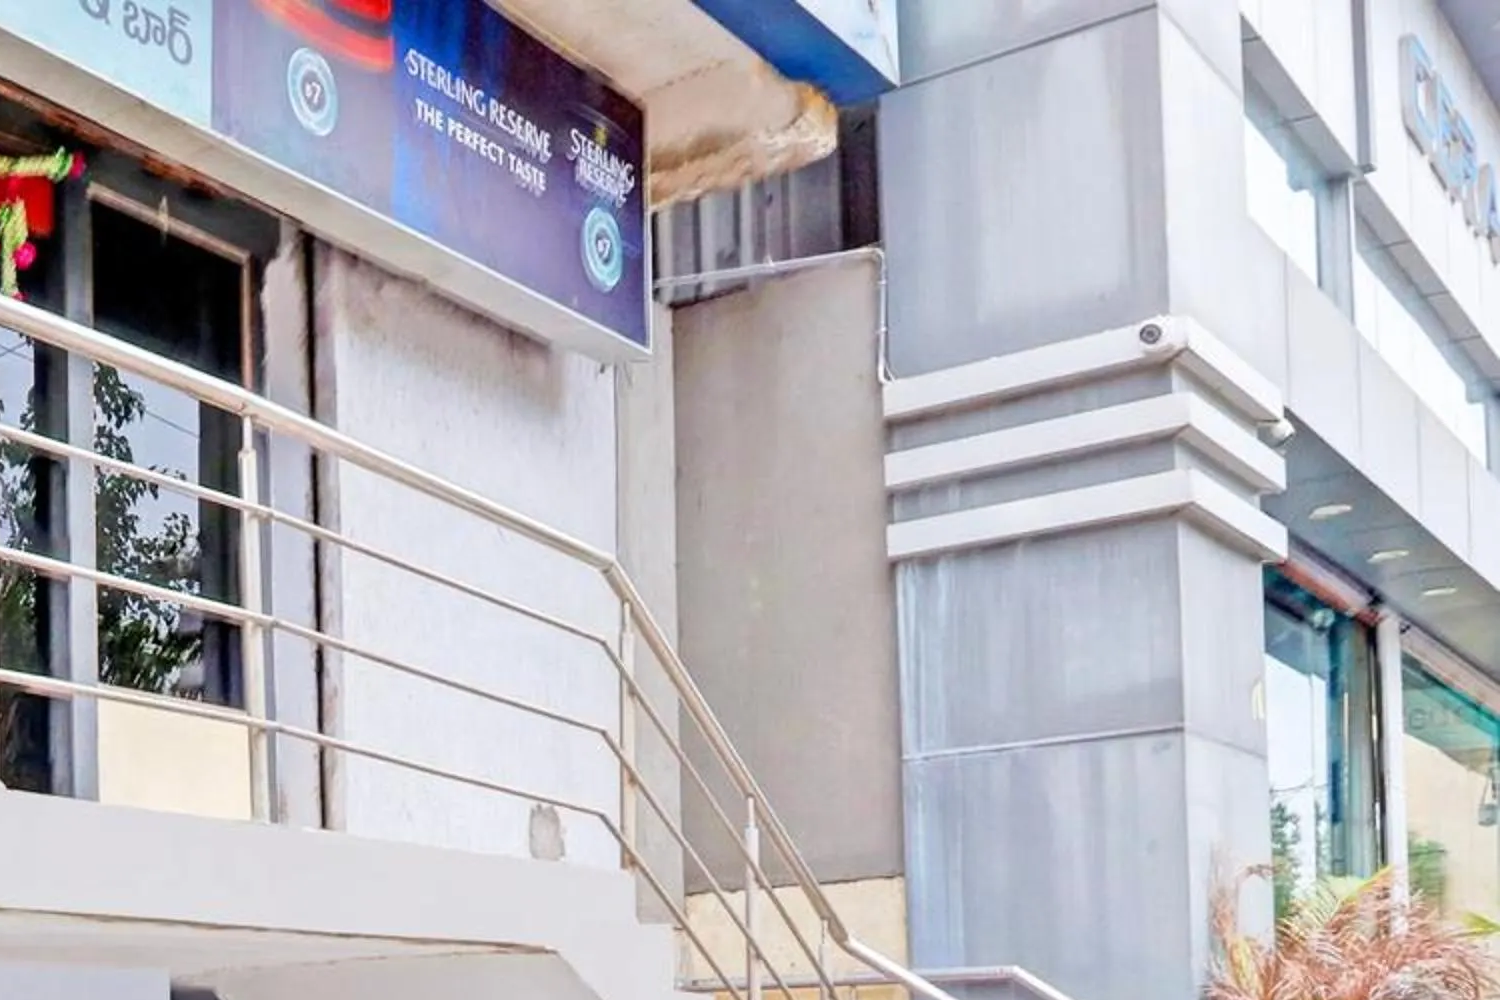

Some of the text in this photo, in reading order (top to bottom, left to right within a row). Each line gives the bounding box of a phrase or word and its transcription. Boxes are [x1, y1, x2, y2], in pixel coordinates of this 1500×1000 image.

[405, 48, 552, 158] STERLING RESERVE
[416, 98, 546, 192] THE PERFECT TASTE
[570, 128, 635, 189] STERLING
